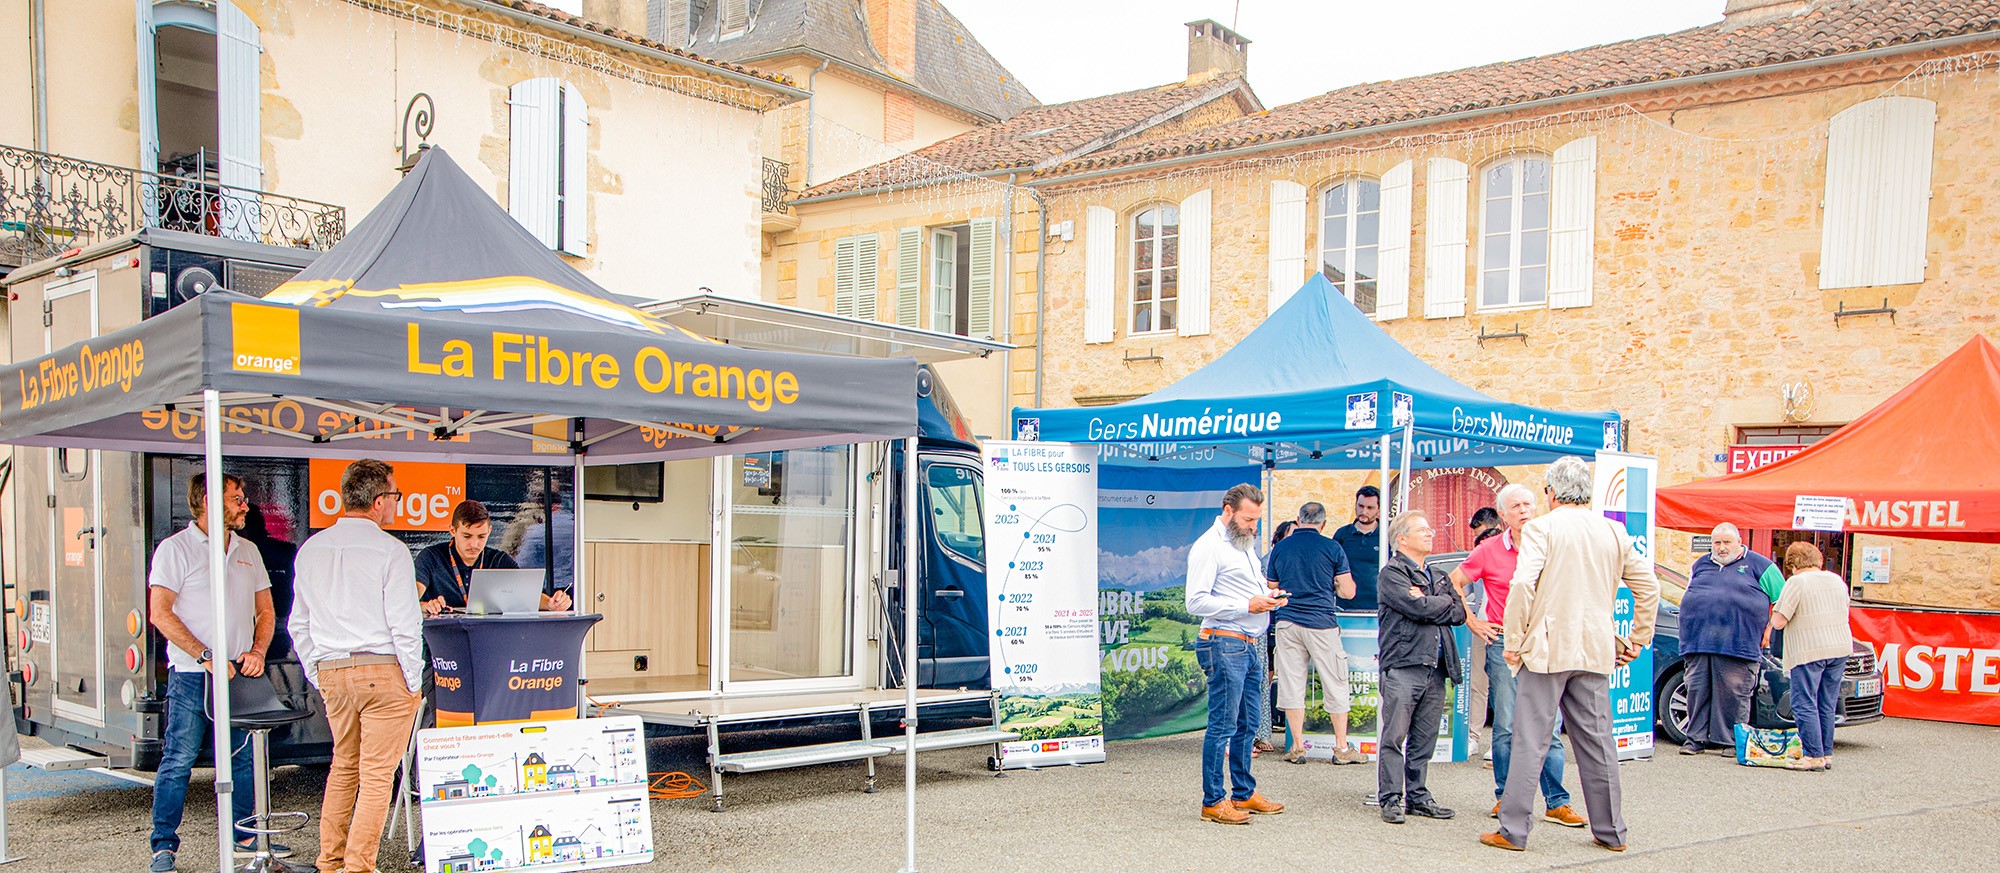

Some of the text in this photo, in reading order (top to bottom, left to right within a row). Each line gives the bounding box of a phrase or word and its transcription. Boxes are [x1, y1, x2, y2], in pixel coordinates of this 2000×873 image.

[20, 339, 144, 410] La Fibre Orange
[407, 322, 799, 412] La Fibre Orange
[1012, 448, 1064, 458] LA FIBRE pour
[1013, 461, 1035, 472] TOUS
[1037, 462, 1053, 472] LES
[1055, 463, 1091, 473] GERSOIS
[1469, 467, 1502, 493] INDI
[318, 489, 450, 526] oge
[1844, 498, 1966, 528] AMSTEL
[994, 514, 1019, 524] 2025
[1033, 534, 1056, 544] 2024
[1020, 561, 1044, 571] 2023
[1008, 594, 1032, 604] 2022
[1098, 591, 1144, 615] IBRE
[1615, 598, 1629, 614] ers
[1004, 626, 1028, 636] 2021
[509, 658, 564, 673] La Fibre
[1110, 646, 1169, 673] VOUS
[1862, 641, 2000, 693] MSTE
[1014, 664, 1038, 674] 2020
[1350, 672, 1378, 682] IBRE
[434, 672, 462, 692] Orange
[508, 676, 562, 692] Orange
[1360, 696, 1378, 706] VO
[1617, 692, 1650, 714] en 2025
